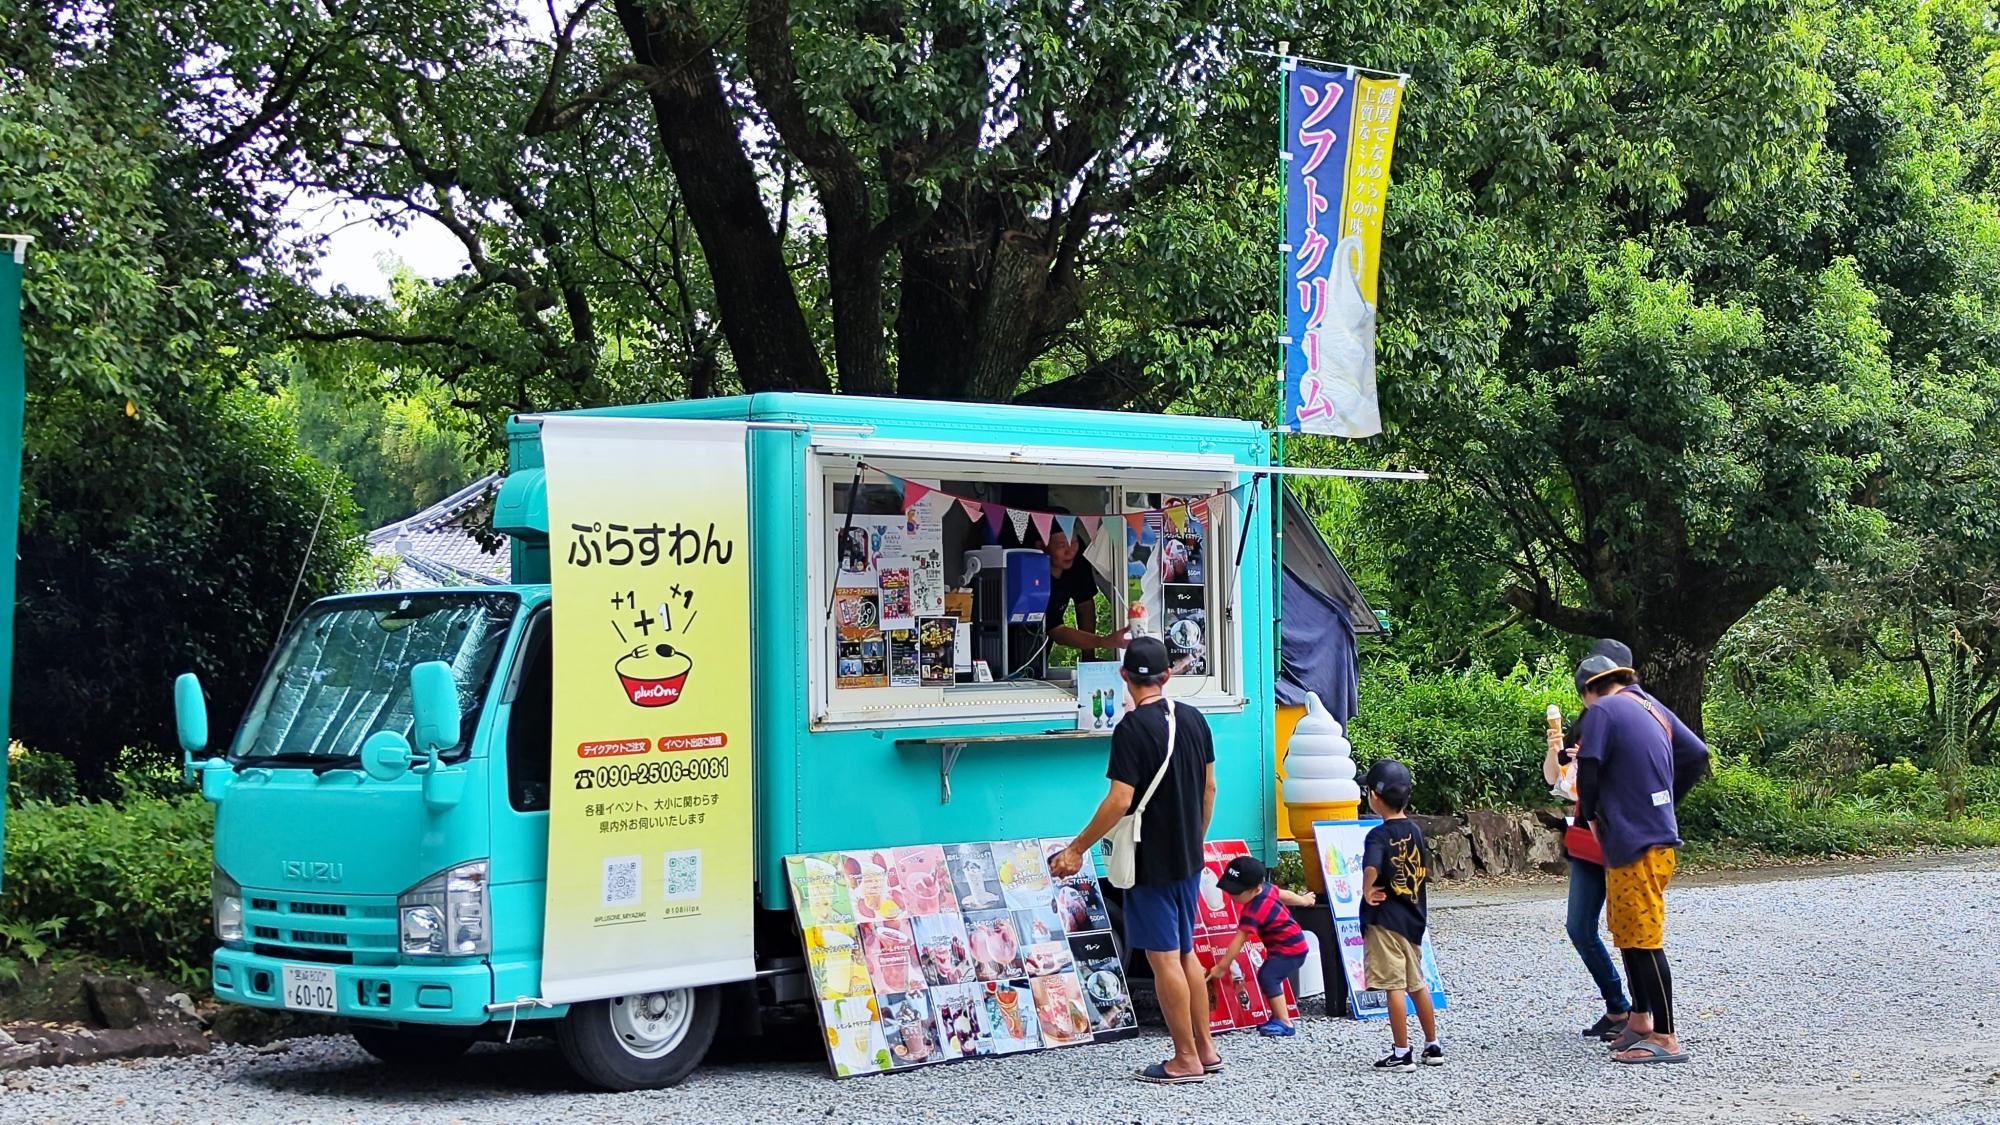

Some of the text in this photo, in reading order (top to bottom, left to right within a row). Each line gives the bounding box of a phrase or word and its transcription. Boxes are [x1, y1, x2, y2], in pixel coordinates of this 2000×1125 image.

[1350, 87, 1376, 235] 上質なミルクの味
[1296, 82, 1344, 422] ソフトクリーム
[568, 522, 733, 567] ぷらすわん
[634, 684, 679, 702] plusOne
[583, 741, 647, 756] テイクアウトご注文
[596, 756, 729, 788] 090-2506-9081
[584, 793, 719, 817] 各種イベント、大小に関わらず
[599, 812, 706, 834] 県内外お伺いいたします
[281, 859, 343, 881] ISUZU
[295, 984, 334, 1009] 60-02
